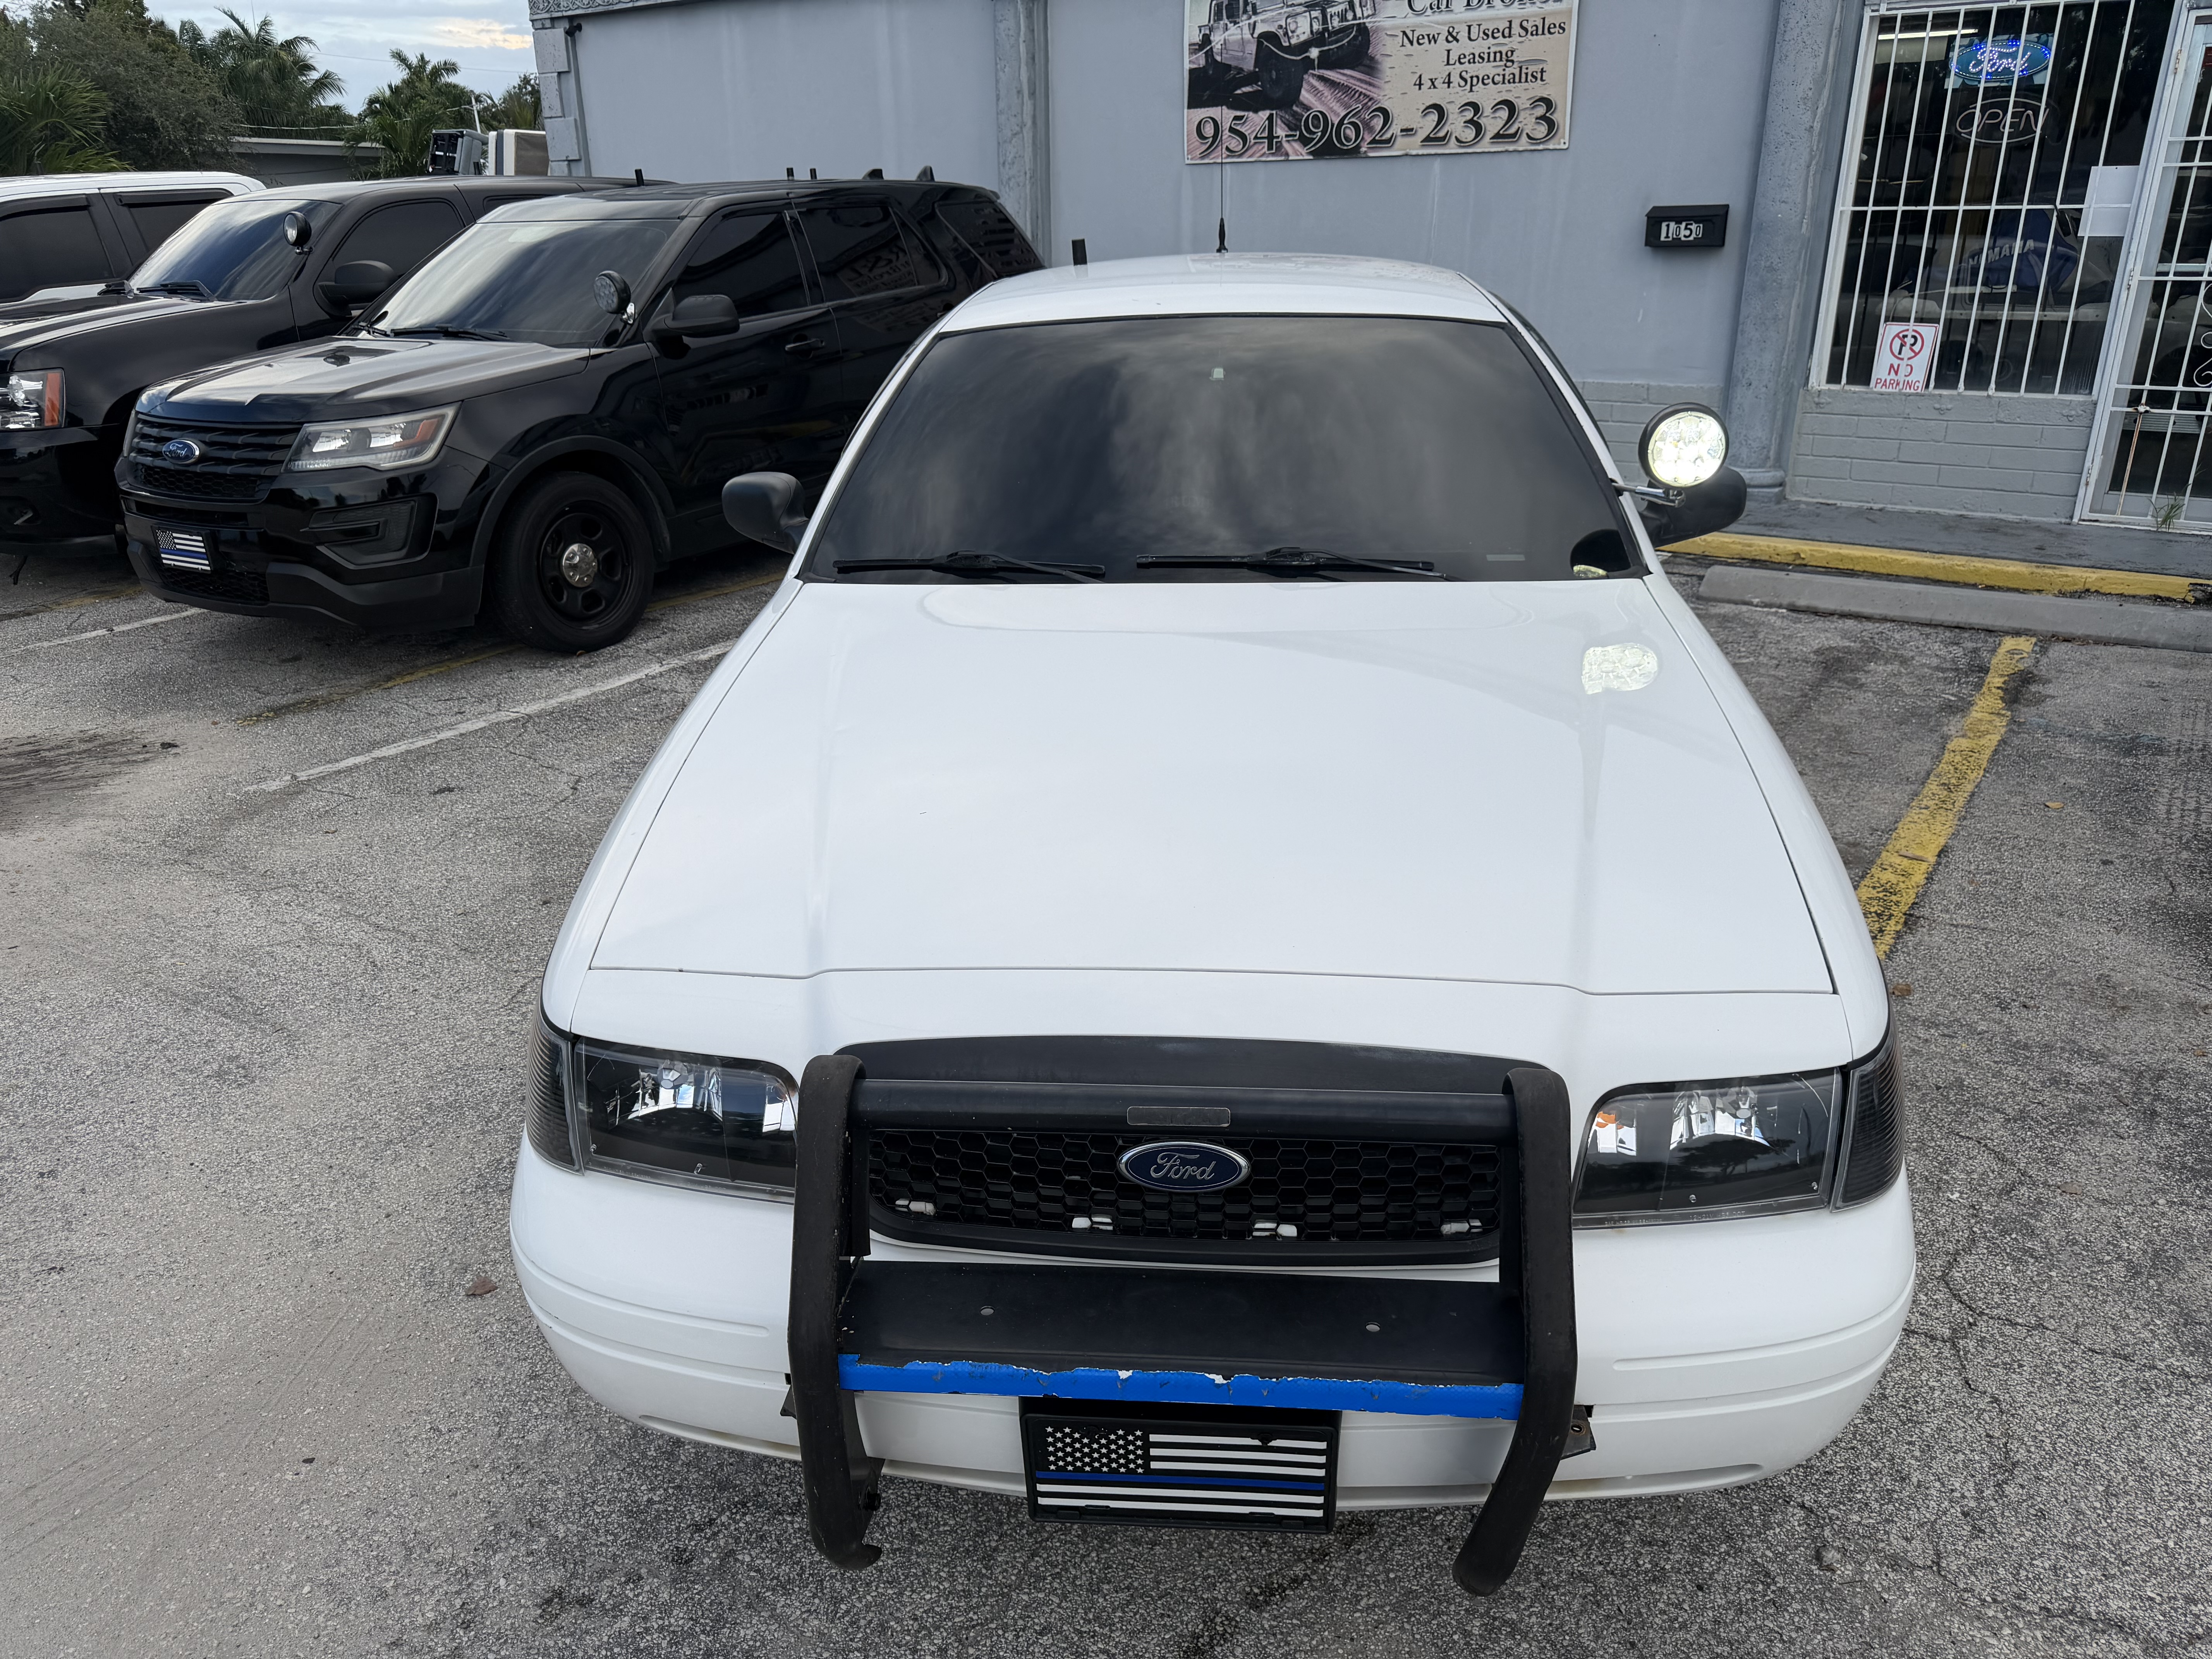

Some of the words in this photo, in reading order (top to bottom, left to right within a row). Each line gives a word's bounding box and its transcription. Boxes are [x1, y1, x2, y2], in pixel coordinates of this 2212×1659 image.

[1400, 29, 1441, 47] New
[1445, 26, 1460, 44] &
[1466, 20, 1513, 41] Used
[1518, 17, 1566, 38] Sales
[1444, 46, 1516, 68] Leasing
[1969, 47, 2031, 73] Ford
[1458, 65, 1547, 93] Specialist
[1195, 96, 1559, 156] 954-962-2323
[1956, 108, 2049, 132] OPEN
[1664, 223, 1701, 239] 1050
[1887, 363, 1913, 377] NO
[1874, 378, 1920, 391] PARKING
[166, 443, 187, 457] Ford
[1150, 1152, 1216, 1180] Ford
